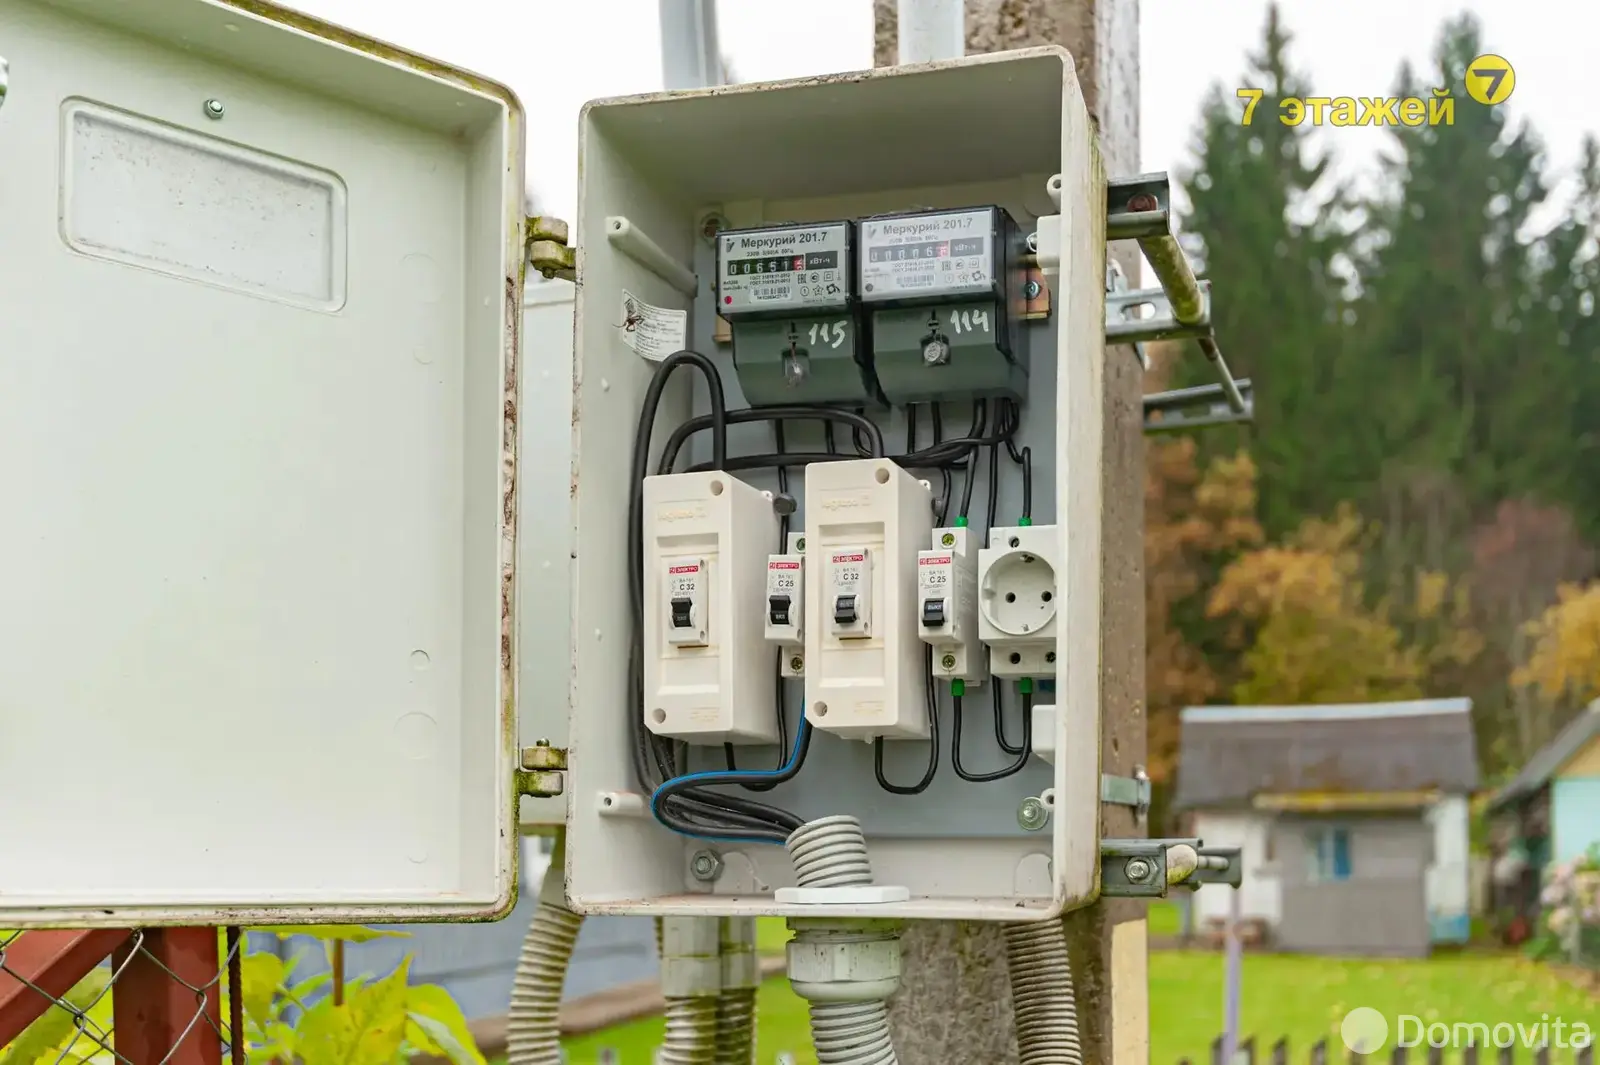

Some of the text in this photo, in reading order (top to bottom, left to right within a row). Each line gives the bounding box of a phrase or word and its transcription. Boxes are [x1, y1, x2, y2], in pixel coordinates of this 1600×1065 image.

[883, 217, 973, 236] Меркурий 201.7
[741, 231, 827, 249] Меркурий 201.7
[950, 309, 989, 334] 114
[808, 320, 848, 349] 115
